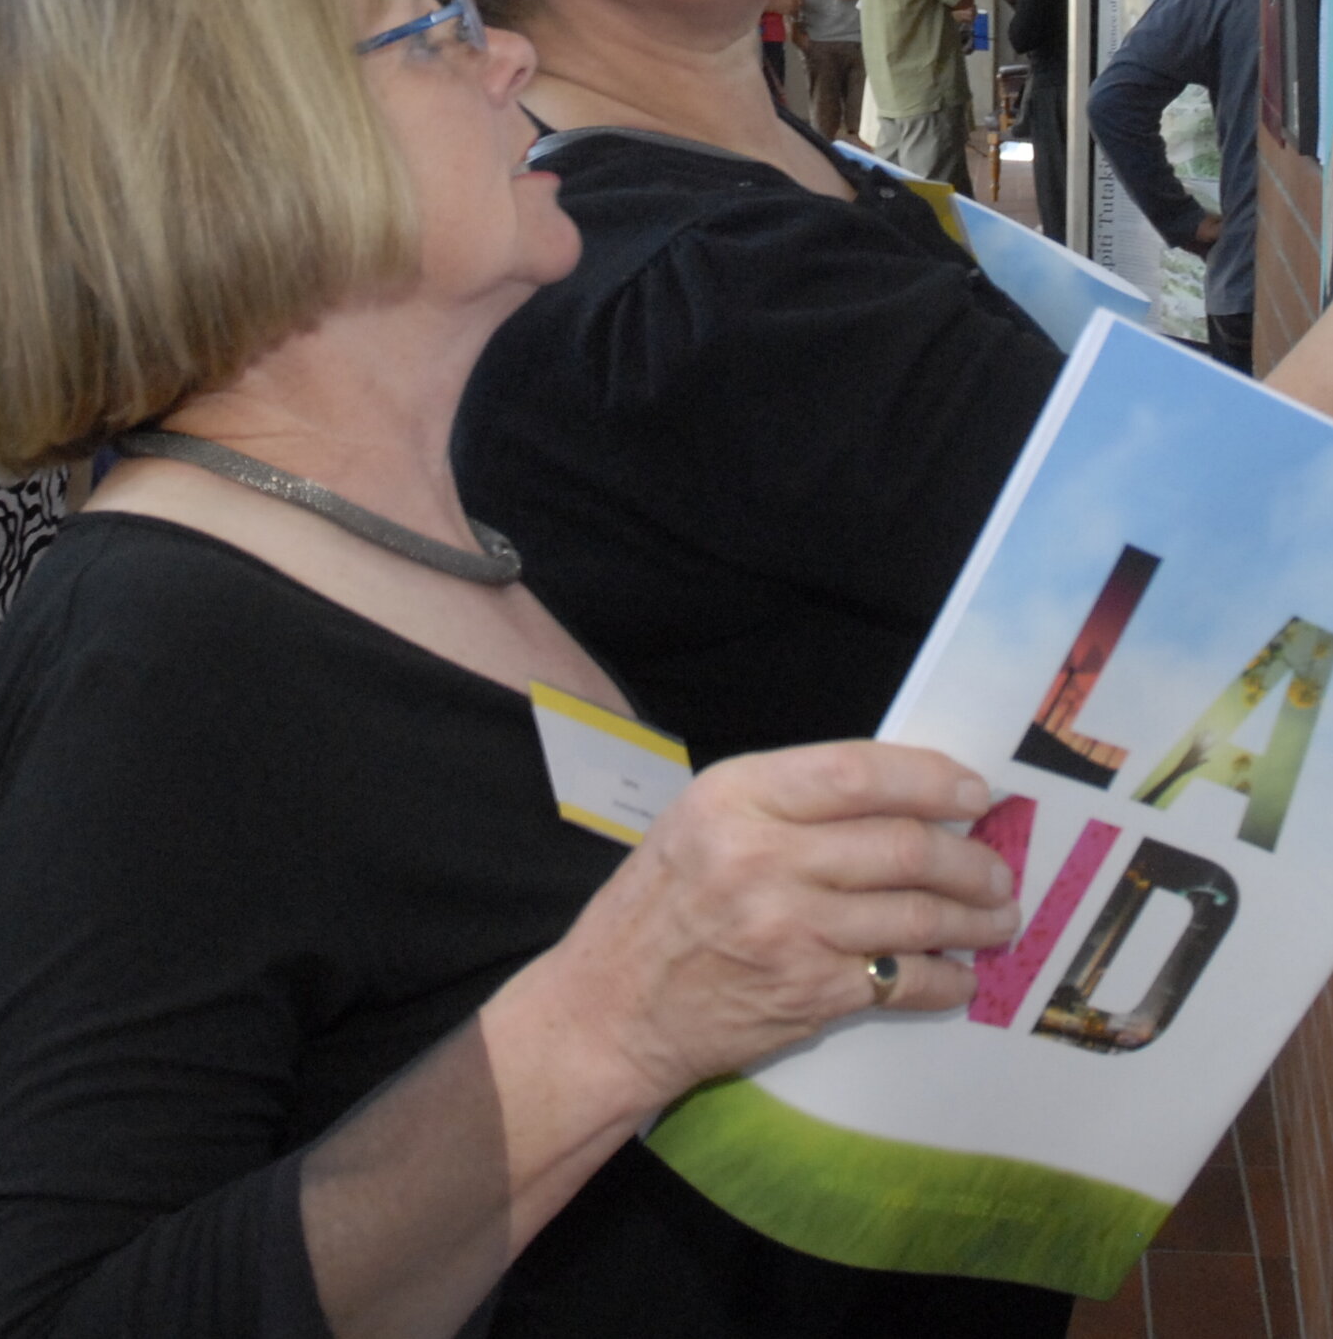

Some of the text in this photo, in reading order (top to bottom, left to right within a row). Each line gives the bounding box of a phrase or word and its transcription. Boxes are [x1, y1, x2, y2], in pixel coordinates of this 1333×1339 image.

[1107, 15, 1118, 55] luence
[1098, 157, 1114, 229] Tutaki
[1097, 233, 1116, 272] piti
